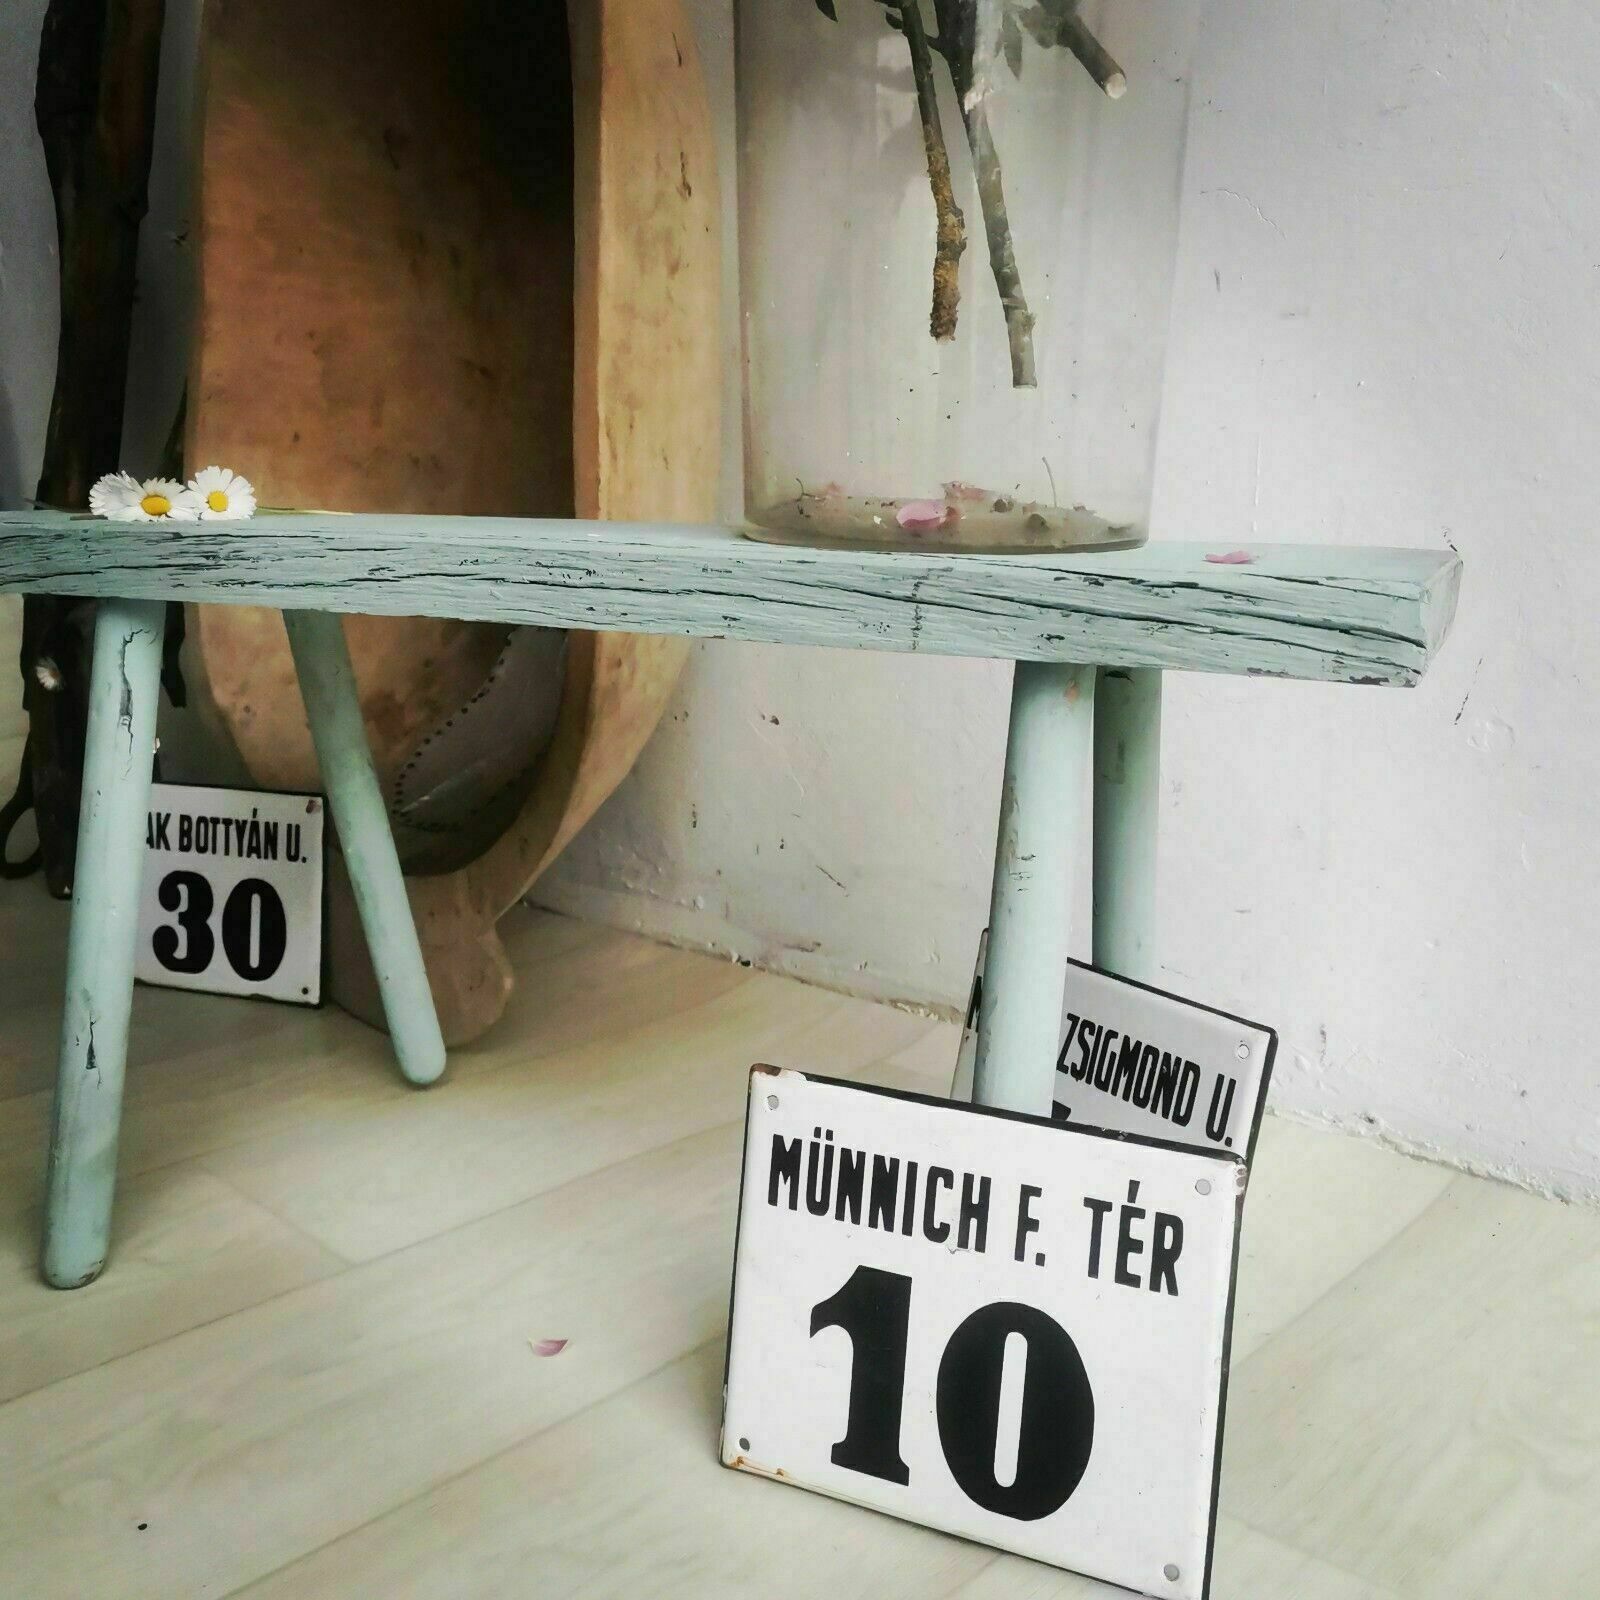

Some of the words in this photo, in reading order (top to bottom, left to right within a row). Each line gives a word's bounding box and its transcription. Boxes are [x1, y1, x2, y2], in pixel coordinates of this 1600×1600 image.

[178, 807, 278, 861] BOTTYÁN
[286, 823, 307, 863] U.
[152, 870, 287, 982] 30
[1056, 1012, 1201, 1127] ZSIGMOND
[1205, 1073, 1237, 1148] U.
[767, 1126, 992, 1253] MÜNNICH
[1014, 1183, 1046, 1267] F.
[1083, 1179, 1184, 1296] TÉR
[809, 1264, 1095, 1522] 10
